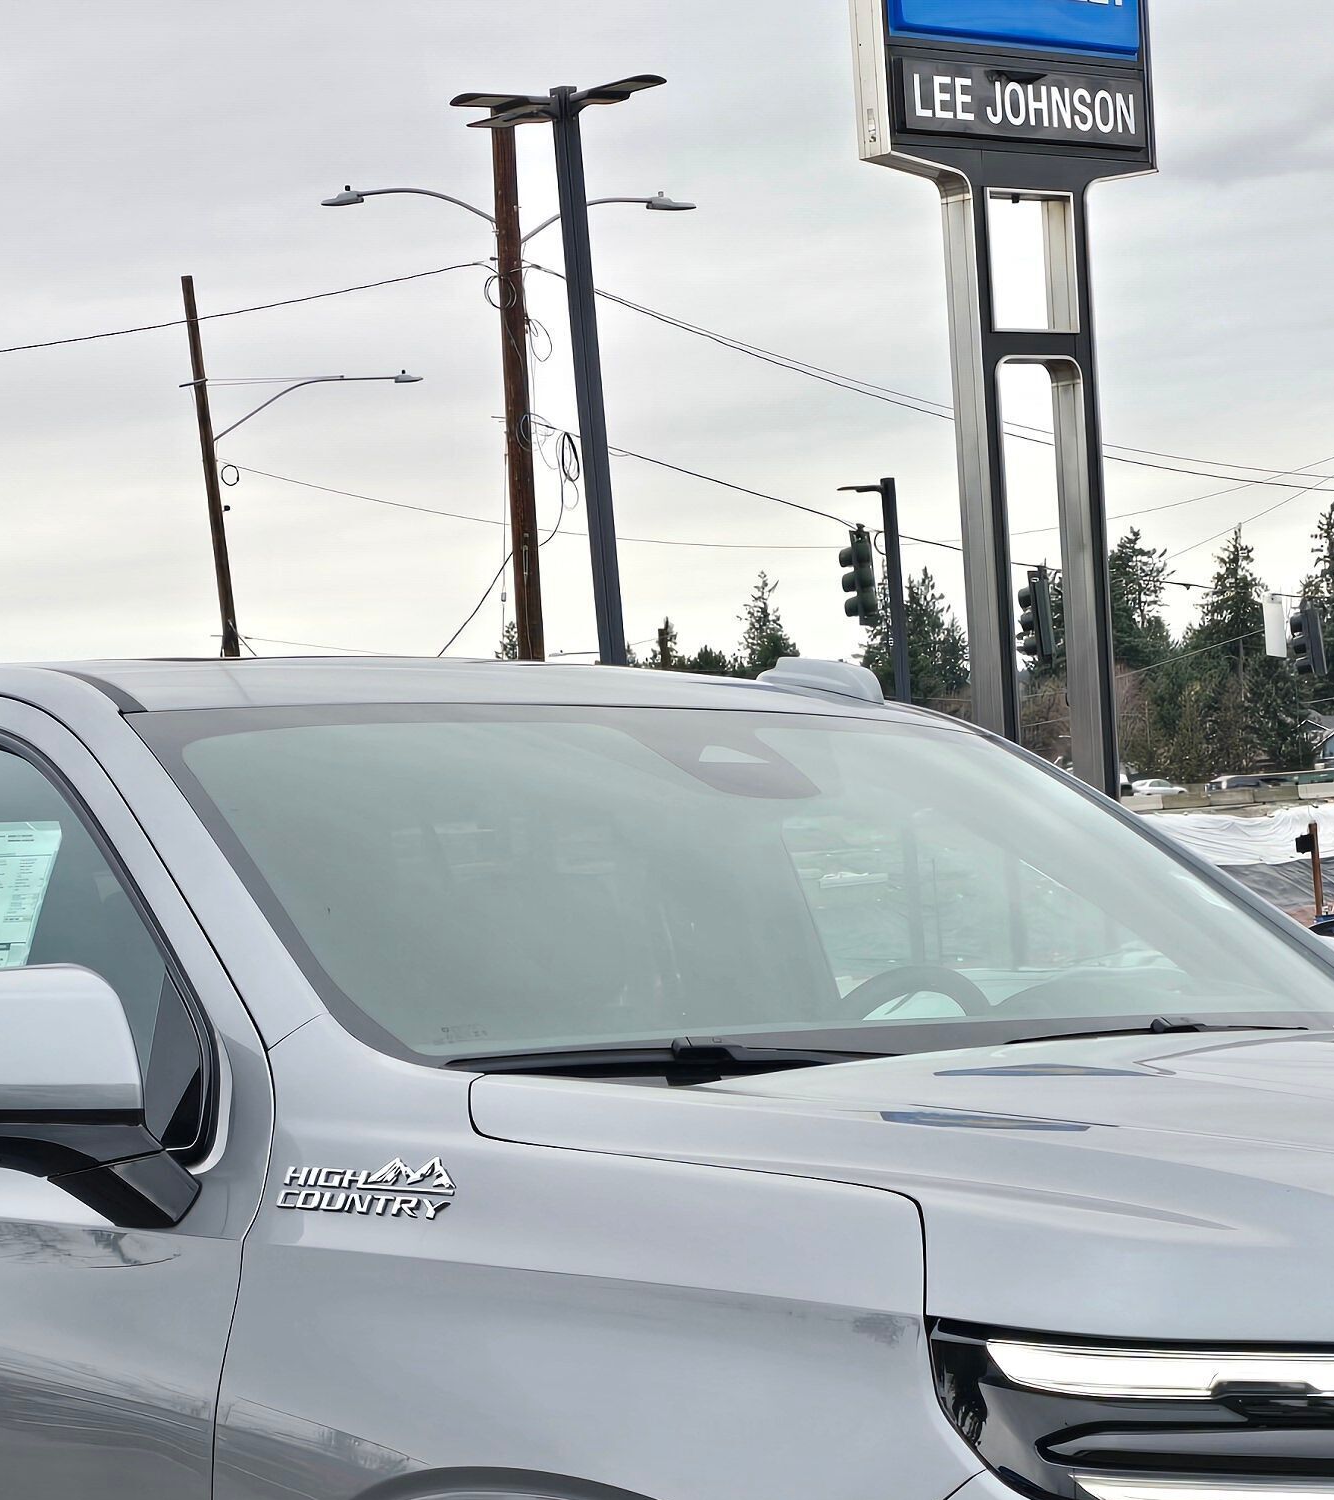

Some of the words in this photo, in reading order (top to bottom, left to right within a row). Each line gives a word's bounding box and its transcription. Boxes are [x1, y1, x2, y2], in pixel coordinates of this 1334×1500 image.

[913, 73, 975, 121] LEE
[986, 81, 1136, 135] JOHNSON
[283, 1165, 371, 1190] HIGH
[276, 1188, 452, 1221] COUNTRY
